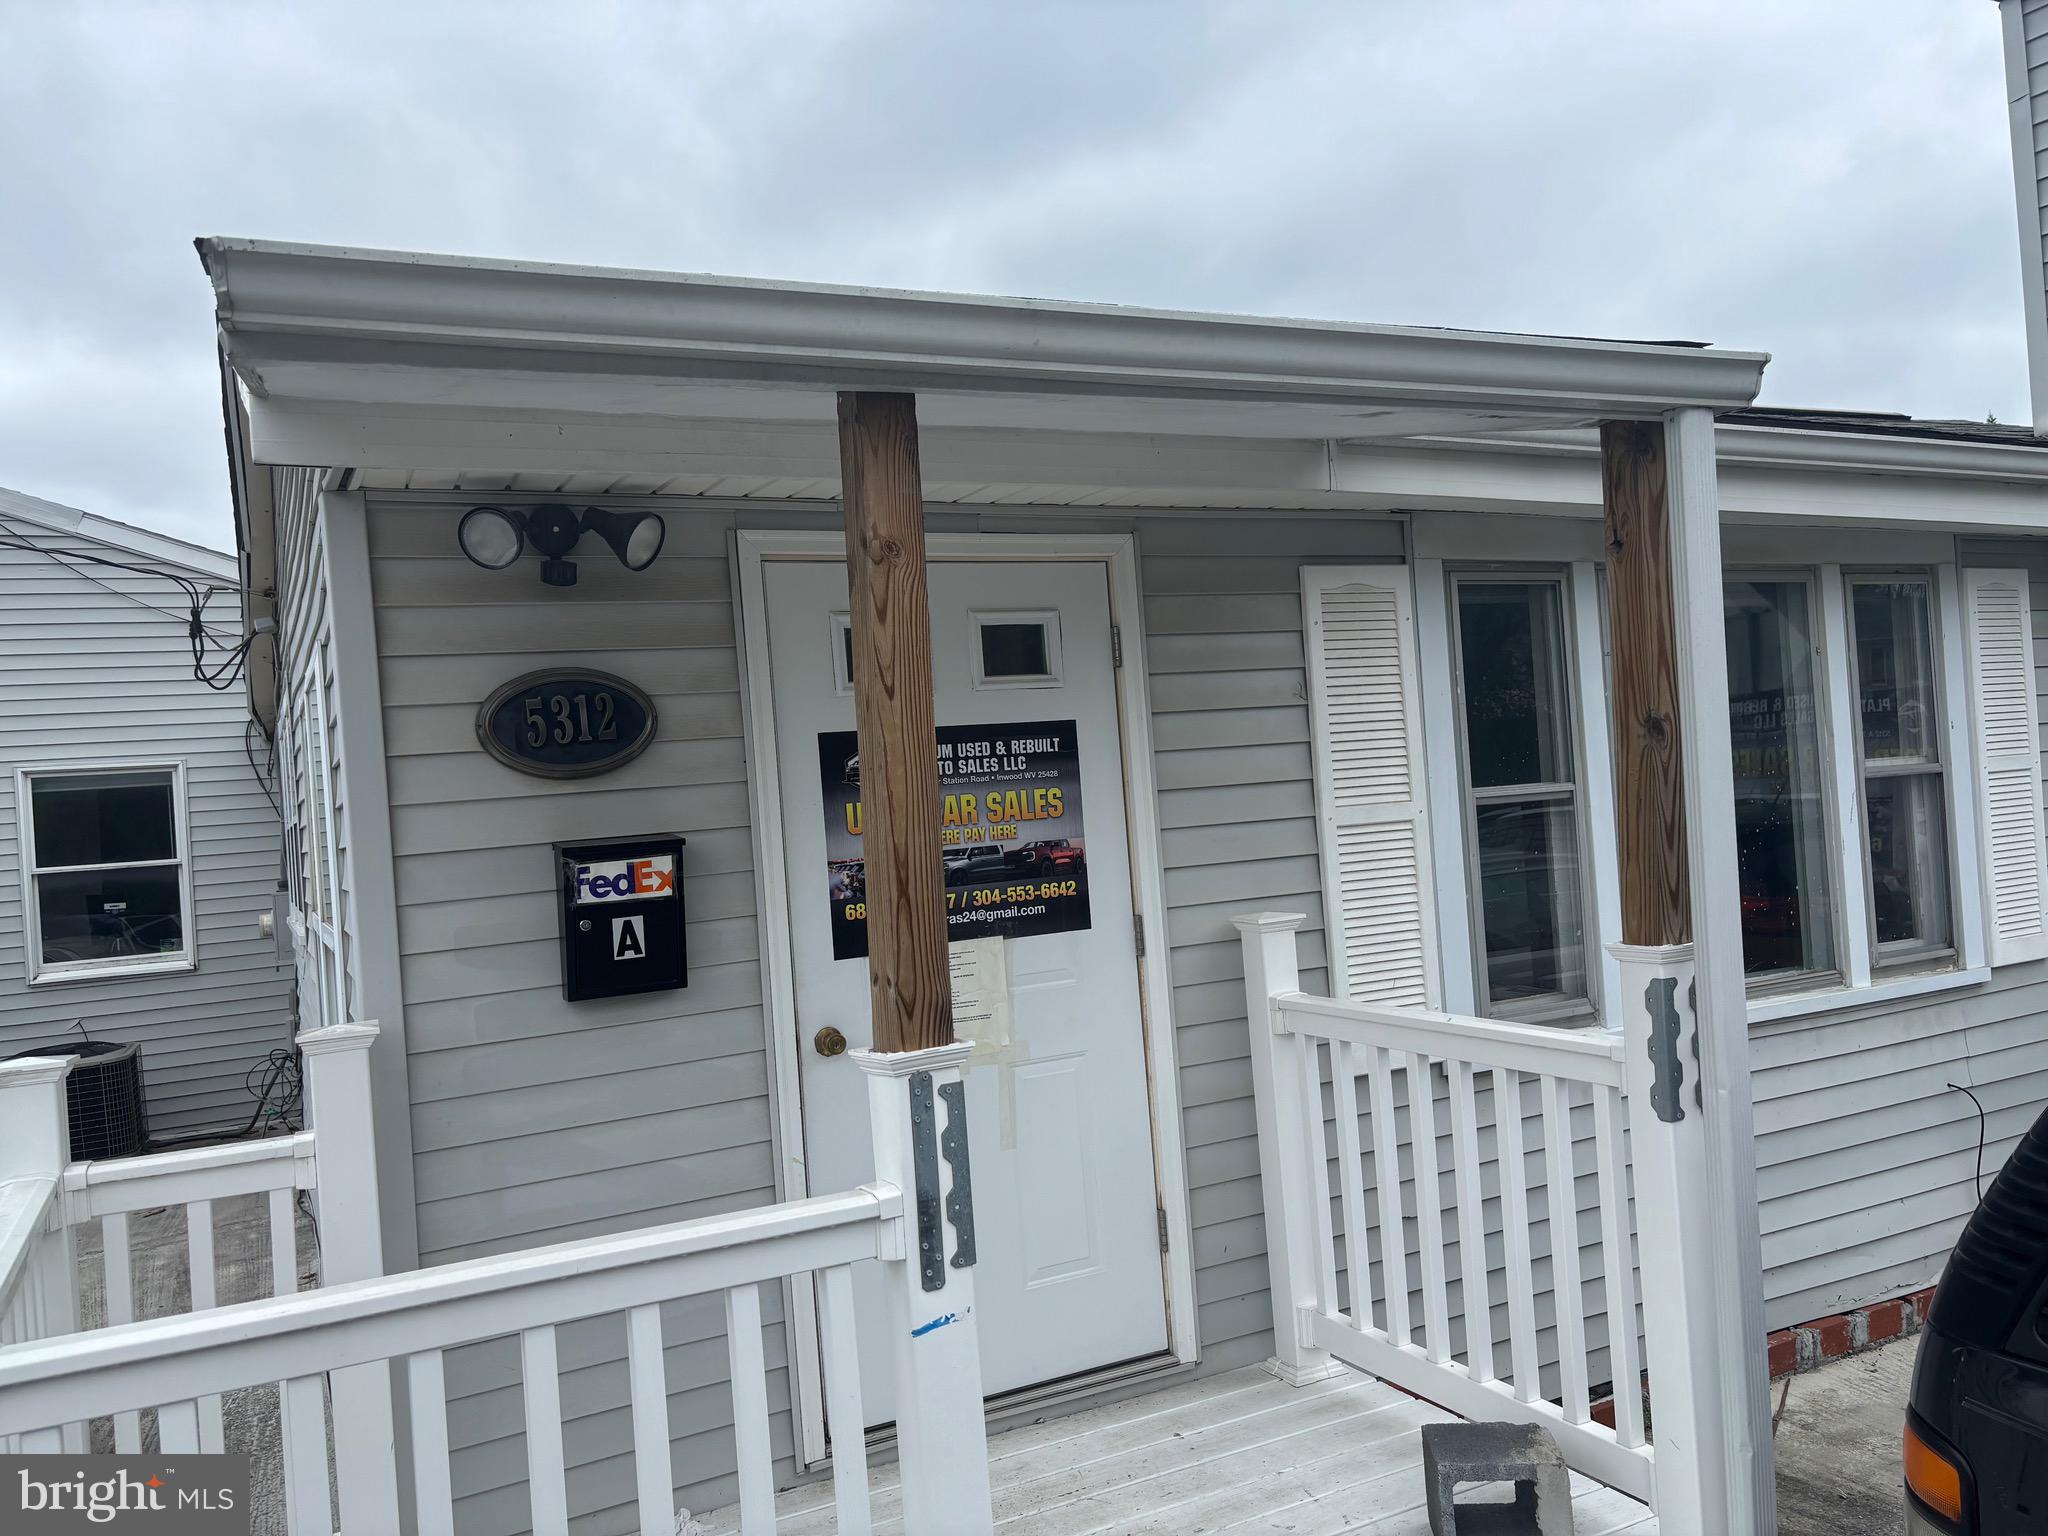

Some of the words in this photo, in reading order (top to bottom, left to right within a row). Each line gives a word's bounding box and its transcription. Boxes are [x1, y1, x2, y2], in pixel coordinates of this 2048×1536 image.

[524, 692, 618, 748] 5312
[937, 743, 953, 758] UM
[957, 741, 991, 758] USED
[995, 741, 1007, 755] &
[1011, 738, 1060, 755] REBUILT
[937, 760, 953, 775] TO
[958, 757, 999, 774] SALES
[1003, 756, 1027, 771] LLC
[942, 775, 969, 785] Station
[970, 774, 990, 783] Road
[996, 771, 1023, 781] Inwood
[1024, 771, 1036, 779] WV
[1037, 770, 1059, 779] 25428
[845, 802, 863, 835] U
[943, 793, 979, 827] AR
[985, 787, 1064, 823] SALES
[942, 828, 961, 845] ERE
[964, 826, 986, 843] PAY
[990, 824, 1018, 841] HERE
[576, 860, 673, 899] FedEx
[845, 902, 866, 921] 68
[946, 892, 956, 909] 7
[972, 880, 1077, 907] 304-553-6642
[947, 905, 1046, 924] as24@gmail.com
[616, 919, 643, 957] A
